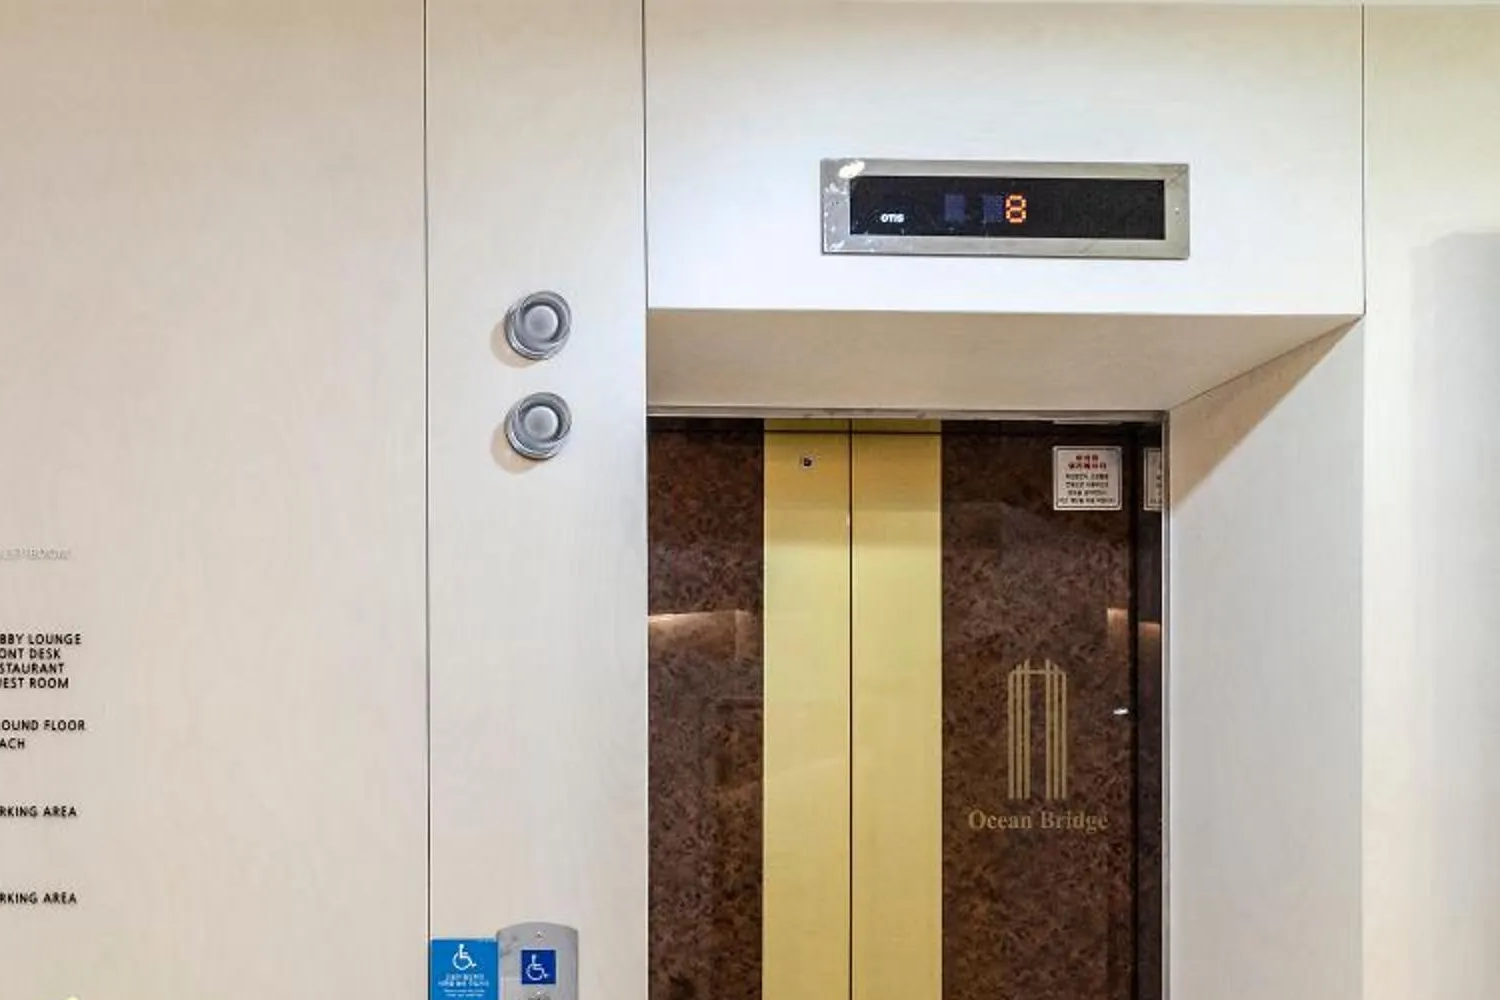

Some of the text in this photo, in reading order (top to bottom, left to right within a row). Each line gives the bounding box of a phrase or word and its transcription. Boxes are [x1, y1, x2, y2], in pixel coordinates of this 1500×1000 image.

[1006, 195, 1026, 223] 8
[880, 214, 904, 222] OTIS
[29, 634, 80, 645] LOUNGE
[30, 648, 60, 660] DESK
[30, 677, 68, 688] ROOM
[44, 720, 84, 731] FLOOR
[43, 806, 76, 817] AREA
[968, 809, 1109, 833] Ocean Bridge
[44, 892, 76, 904] AREA
